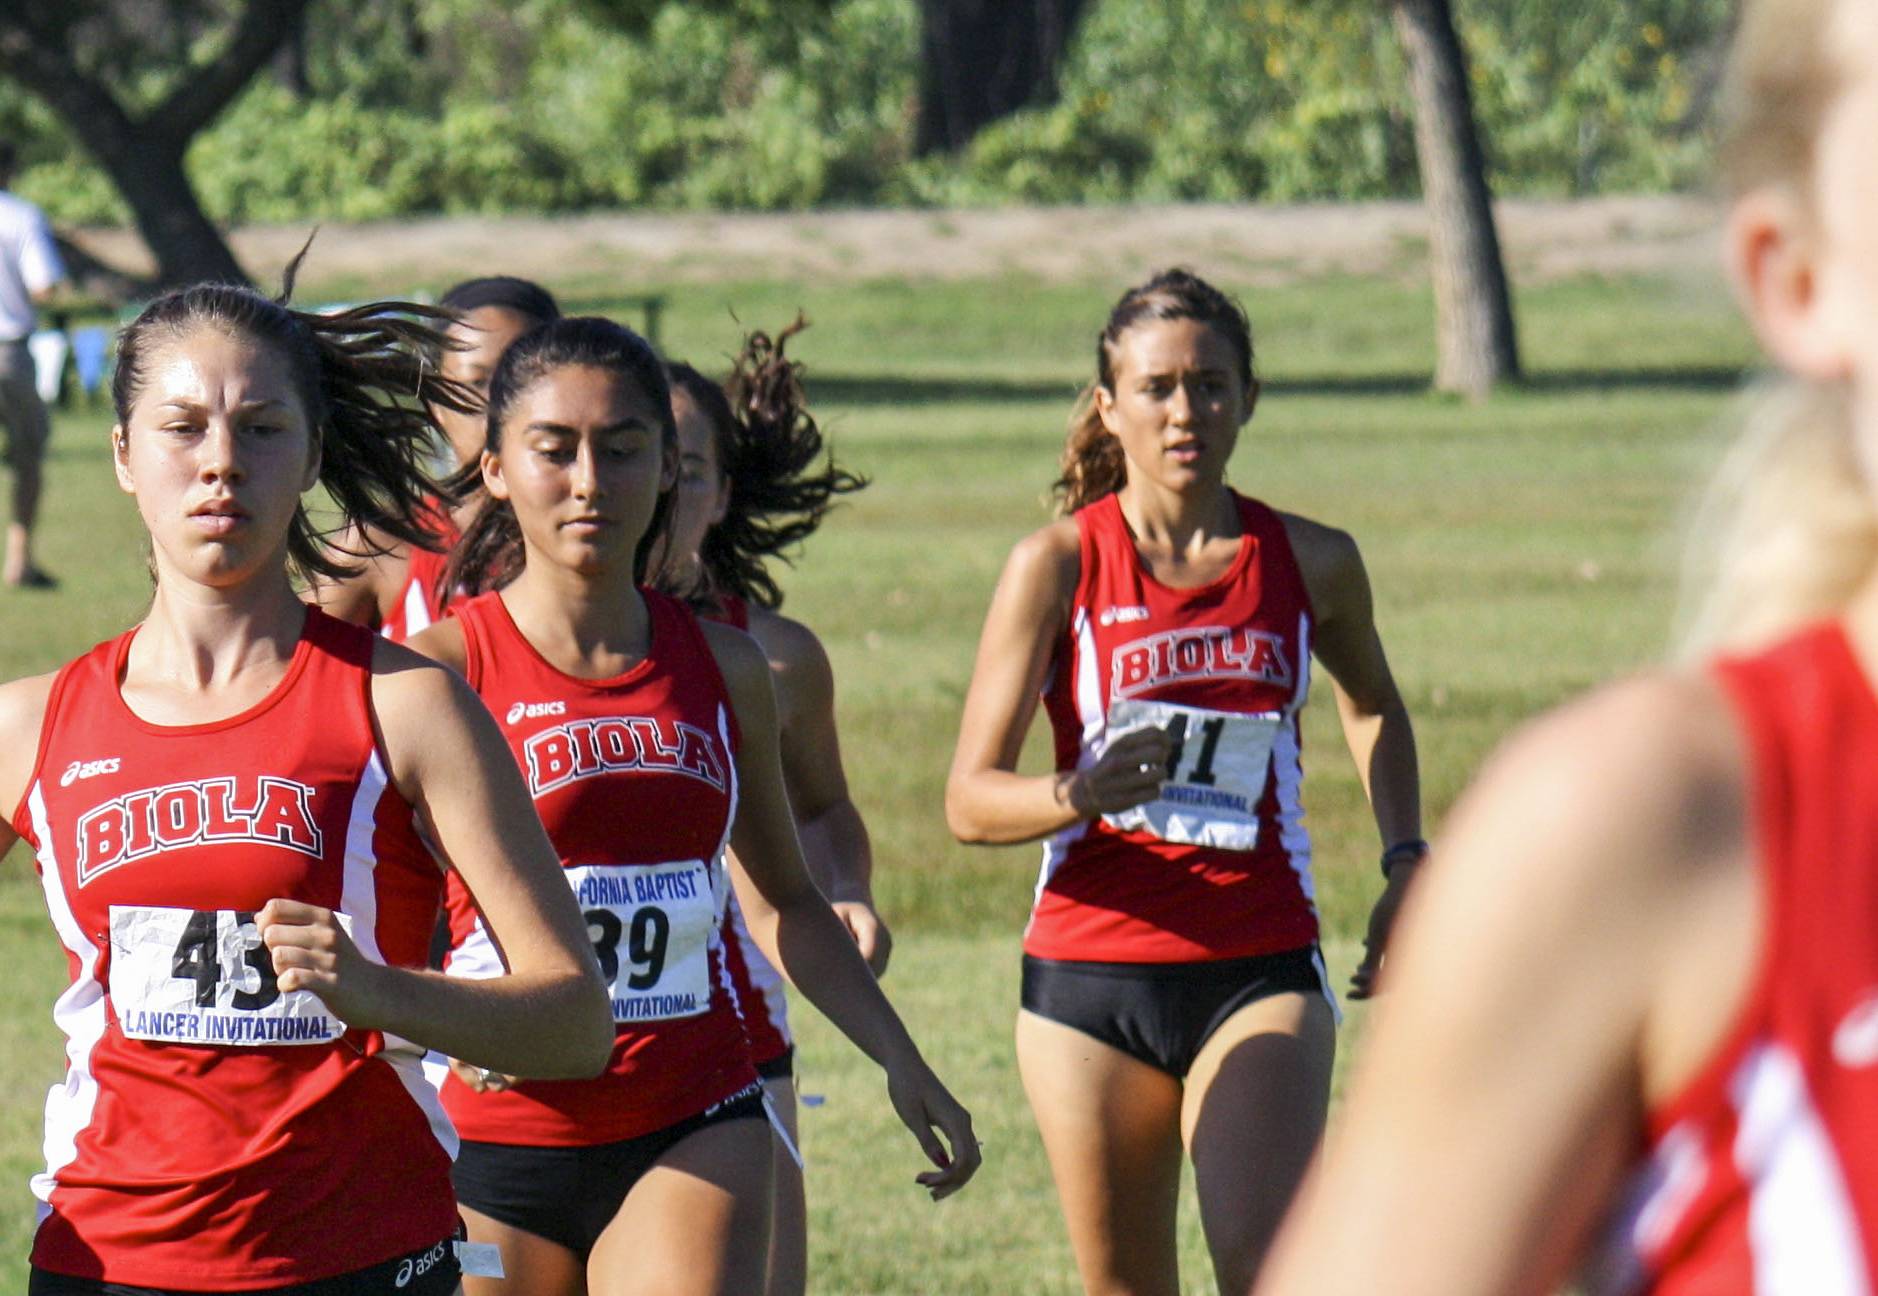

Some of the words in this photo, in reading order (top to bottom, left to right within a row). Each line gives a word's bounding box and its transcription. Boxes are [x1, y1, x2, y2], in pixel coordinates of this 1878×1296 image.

[1111, 625, 1293, 698] BIOLA
[525, 701, 566, 718] asics
[78, 757, 121, 780] asics
[523, 715, 726, 800] BIOLA
[76, 775, 323, 890] BIOLA
[574, 875, 634, 906] FORNIA
[634, 871, 697, 902] BAPTIST
[611, 993, 697, 1019] NVITATIONAL
[125, 1009, 199, 1038] LANCER
[205, 1014, 332, 1041] INVITATIONAL
[415, 1241, 445, 1276] asics
